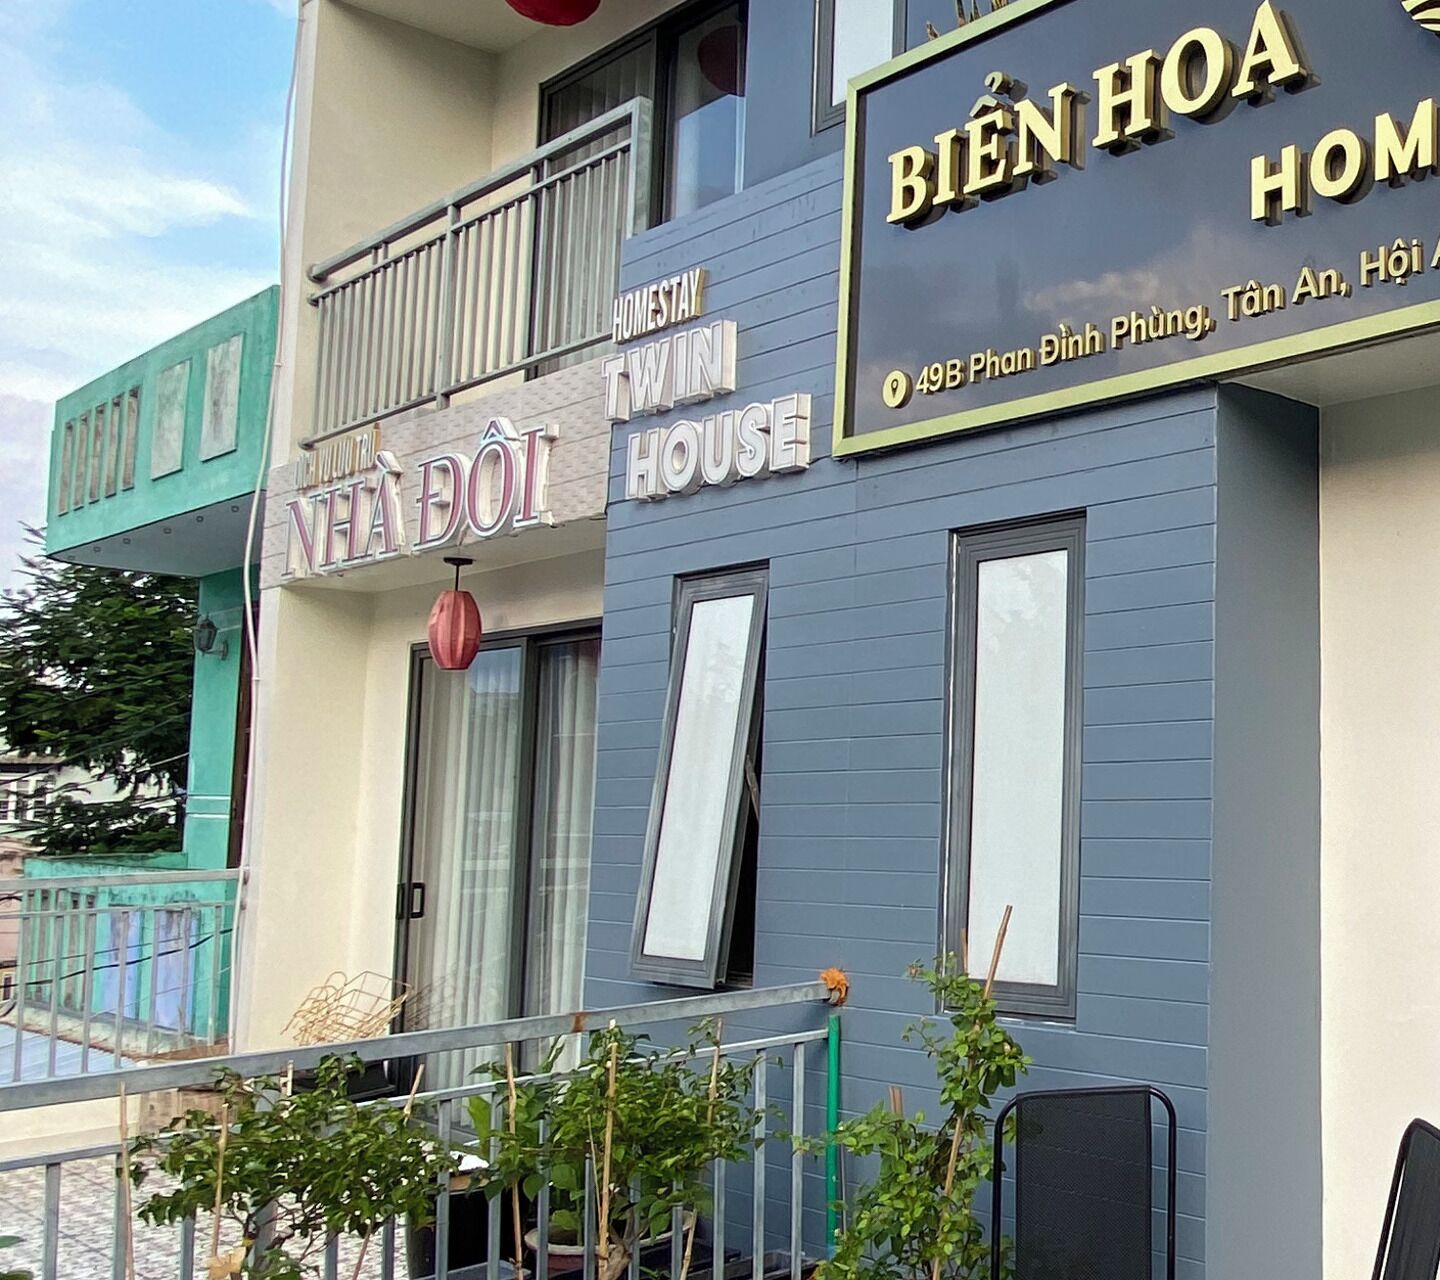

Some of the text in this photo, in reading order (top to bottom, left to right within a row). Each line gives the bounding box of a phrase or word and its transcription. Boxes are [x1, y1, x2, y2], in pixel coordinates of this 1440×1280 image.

[886, 0, 1306, 224] BIỂN HOA
[601, 319, 737, 421] TWIN
[611, 266, 706, 344] HOMESTAY
[915, 358, 964, 396] 49B
[969, 347, 1035, 384] Phan
[1039, 323, 1105, 366] Đình
[1111, 303, 1214, 349] Phùng,
[1221, 279, 1285, 321] Tân
[1292, 266, 1351, 305] An,
[1360, 237, 1424, 286] Hội
[281, 416, 560, 579] NHÀ ĐÔI
[625, 393, 812, 502] HOUSE
